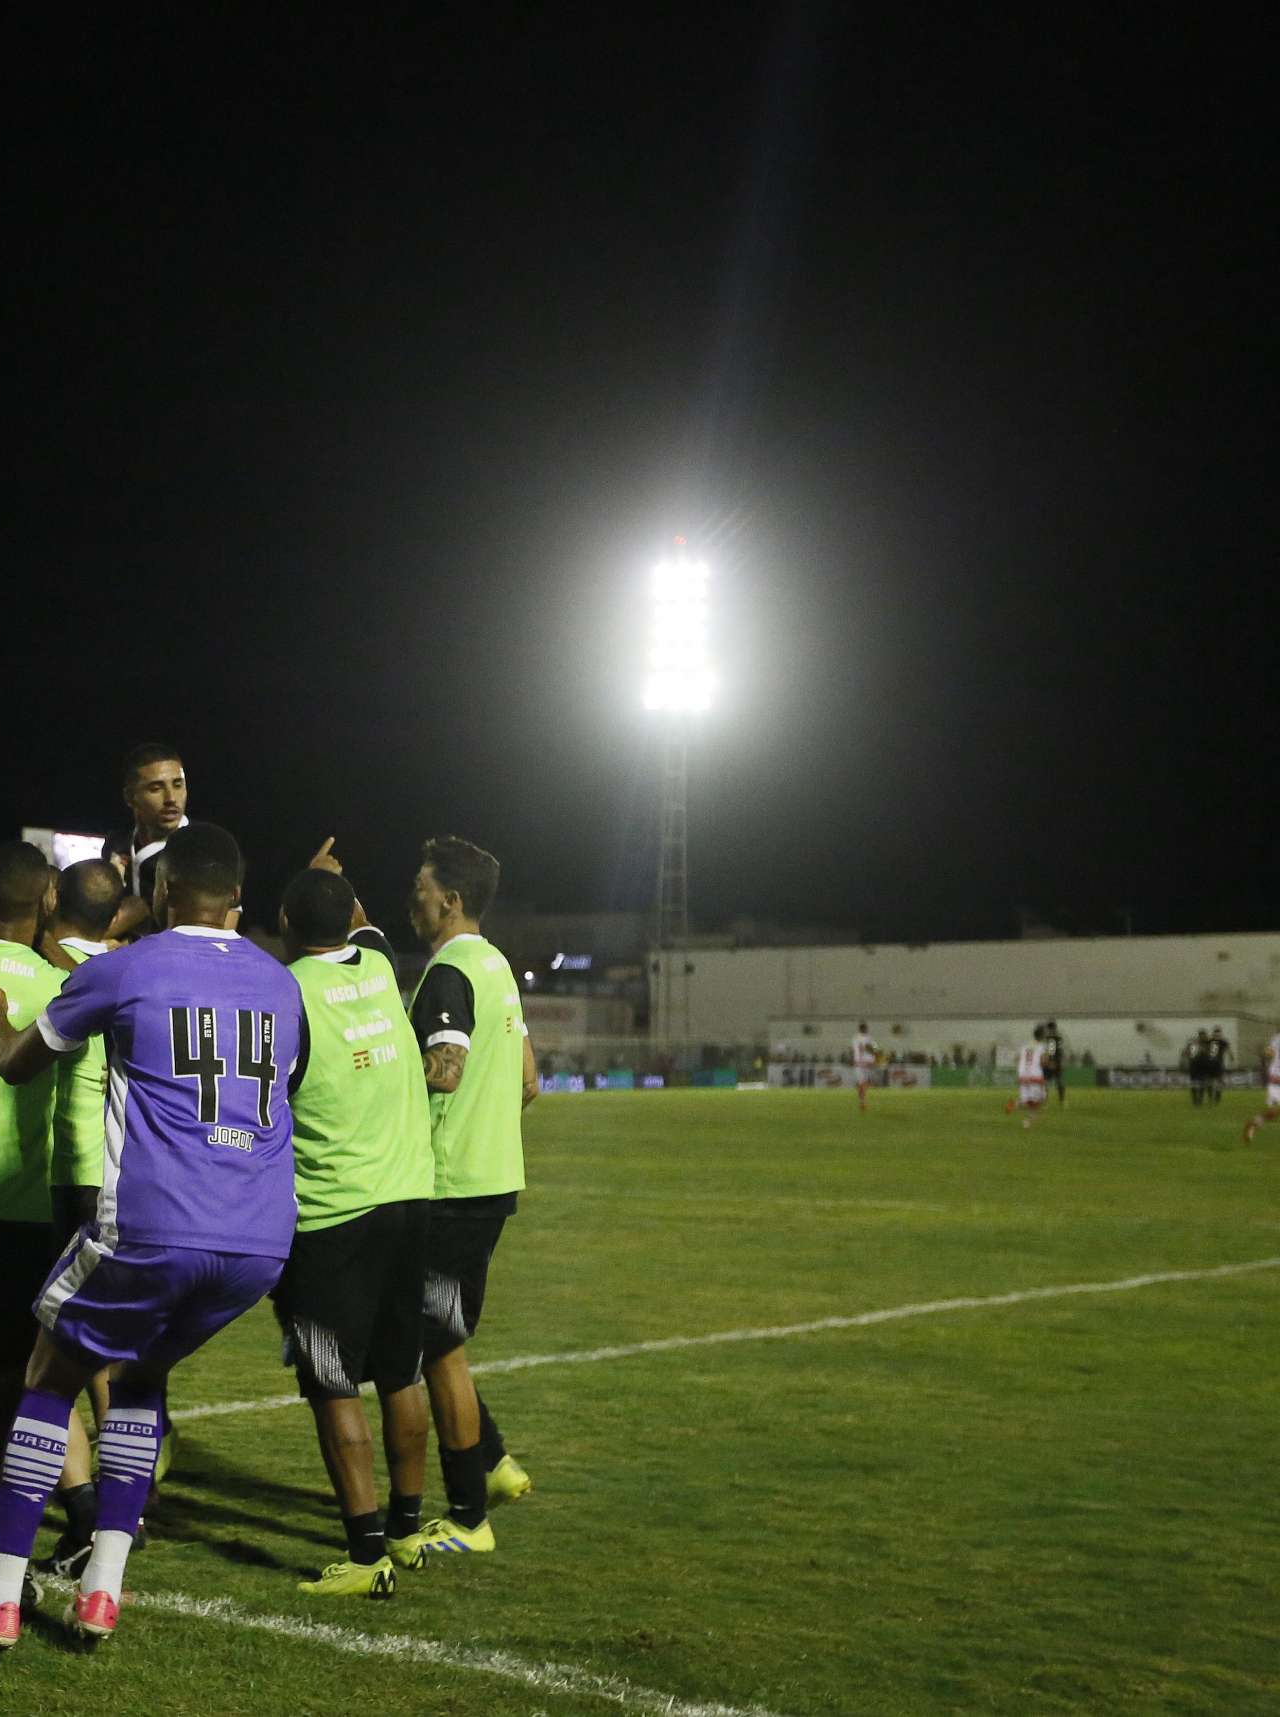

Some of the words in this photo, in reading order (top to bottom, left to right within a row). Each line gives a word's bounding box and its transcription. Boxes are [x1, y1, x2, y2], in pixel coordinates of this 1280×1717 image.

[204, 1014, 212, 1030] TIM
[264, 1020, 272, 1035] TIM
[370, 1043, 398, 1065] TIM
[169, 1007, 277, 1128] 44
[207, 1125, 255, 1152] JORDI
